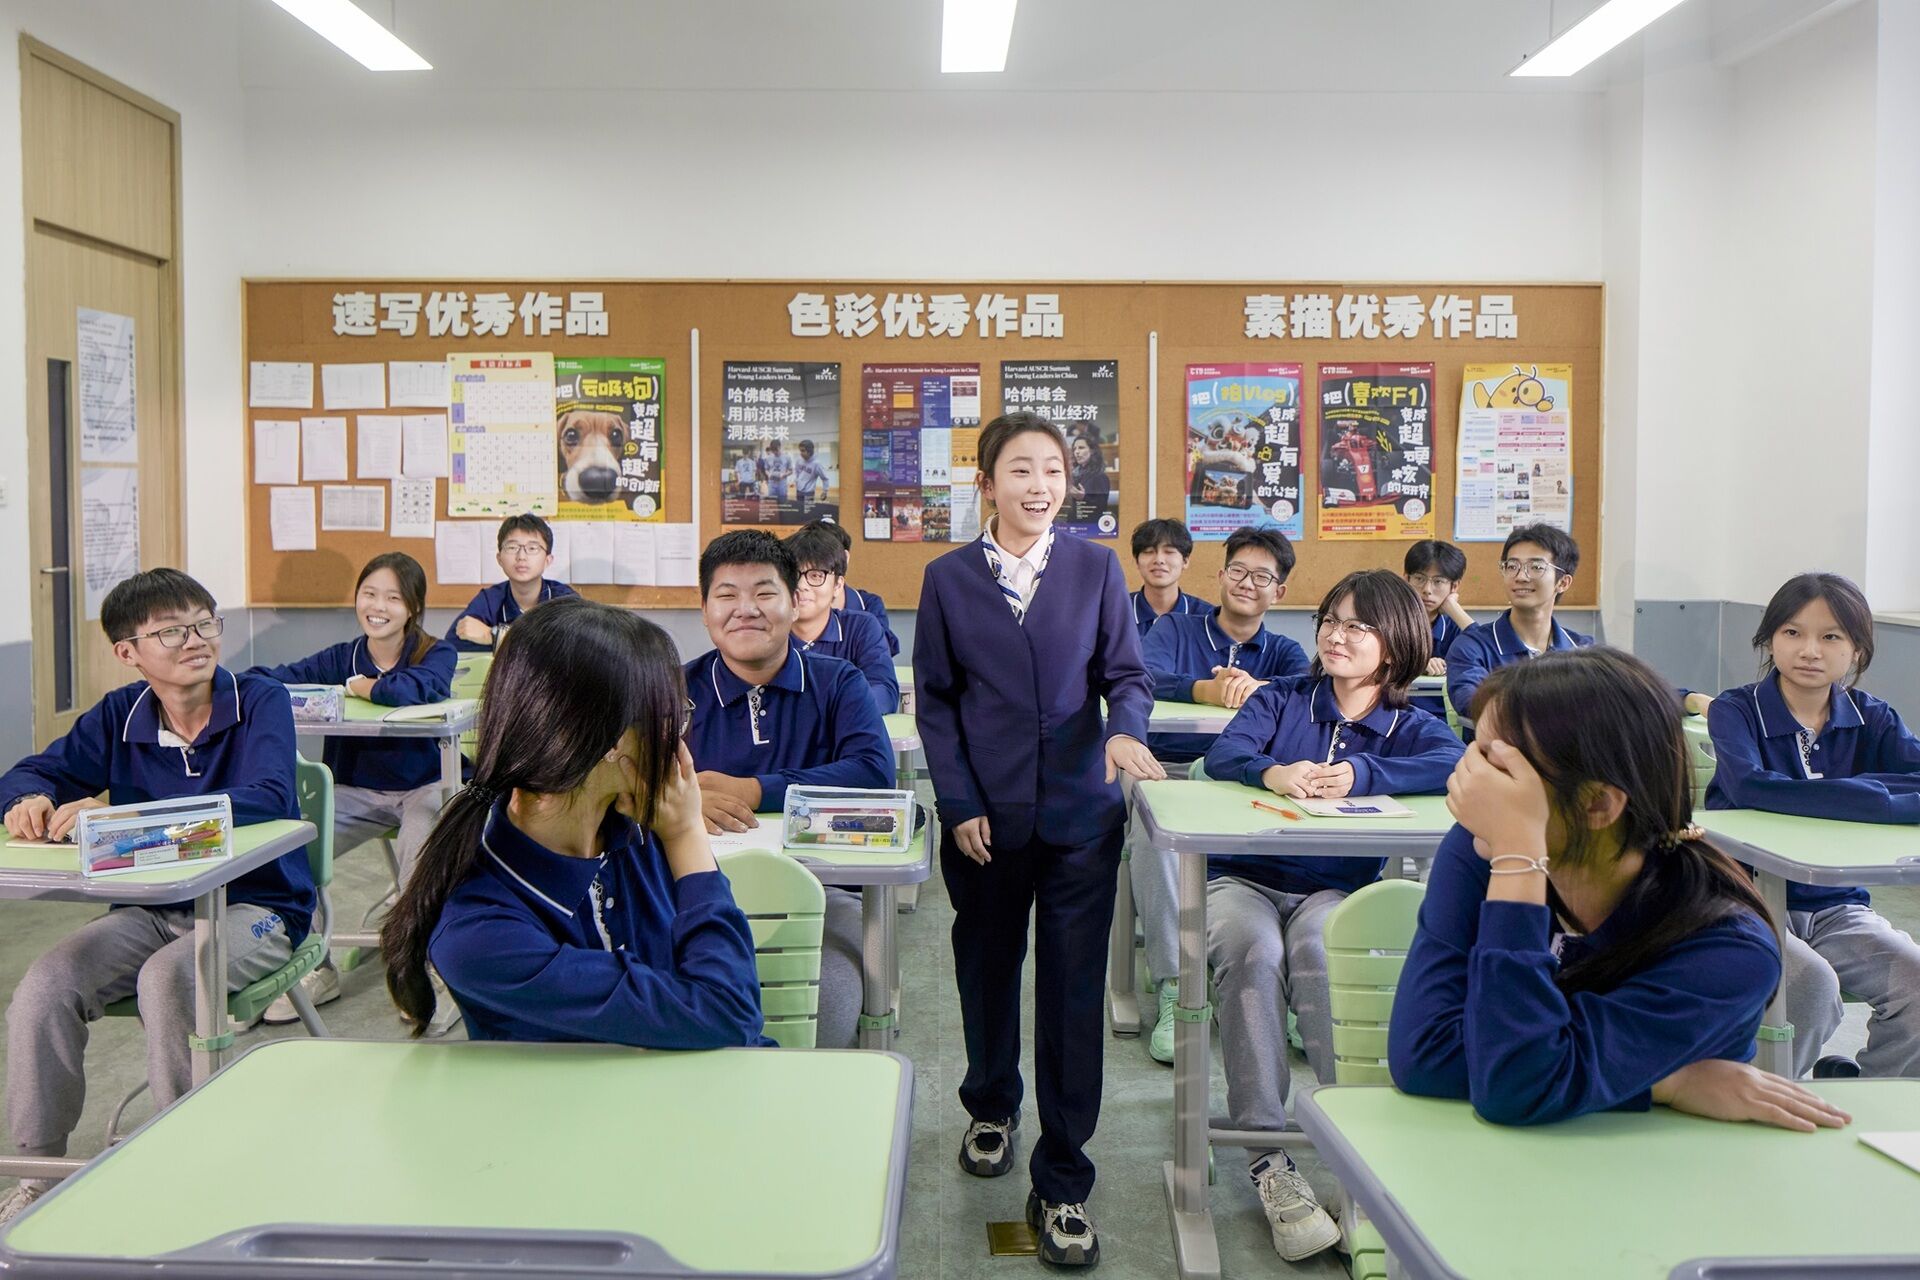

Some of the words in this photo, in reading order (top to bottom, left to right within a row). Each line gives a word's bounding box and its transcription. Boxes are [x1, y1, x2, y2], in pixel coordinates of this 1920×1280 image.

[333, 291, 609, 336] 速写优秀作品
[787, 293, 1064, 337] 色彩优秀作品
[1244, 294, 1518, 338] 素描优秀作品
[737, 373, 754, 381] Young
[1014, 372, 1031, 380] Young
[728, 387, 790, 403] 哈佛峰会
[1004, 386, 1067, 402] 哈佛峰会
[728, 406, 806, 422] 用前沿科技
[1269, 407, 1296, 422] 变成
[1400, 407, 1428, 422] 变成
[630, 418, 655, 441] 超
[728, 425, 789, 440] 洞悉未来
[1264, 422, 1289, 445] 超
[1398, 422, 1424, 445] 超
[1280, 446, 1298, 466] 有
[615, 476, 660, 493] 的创新
[1257, 485, 1298, 499] 的公益
[1387, 481, 1430, 499] 的研究
